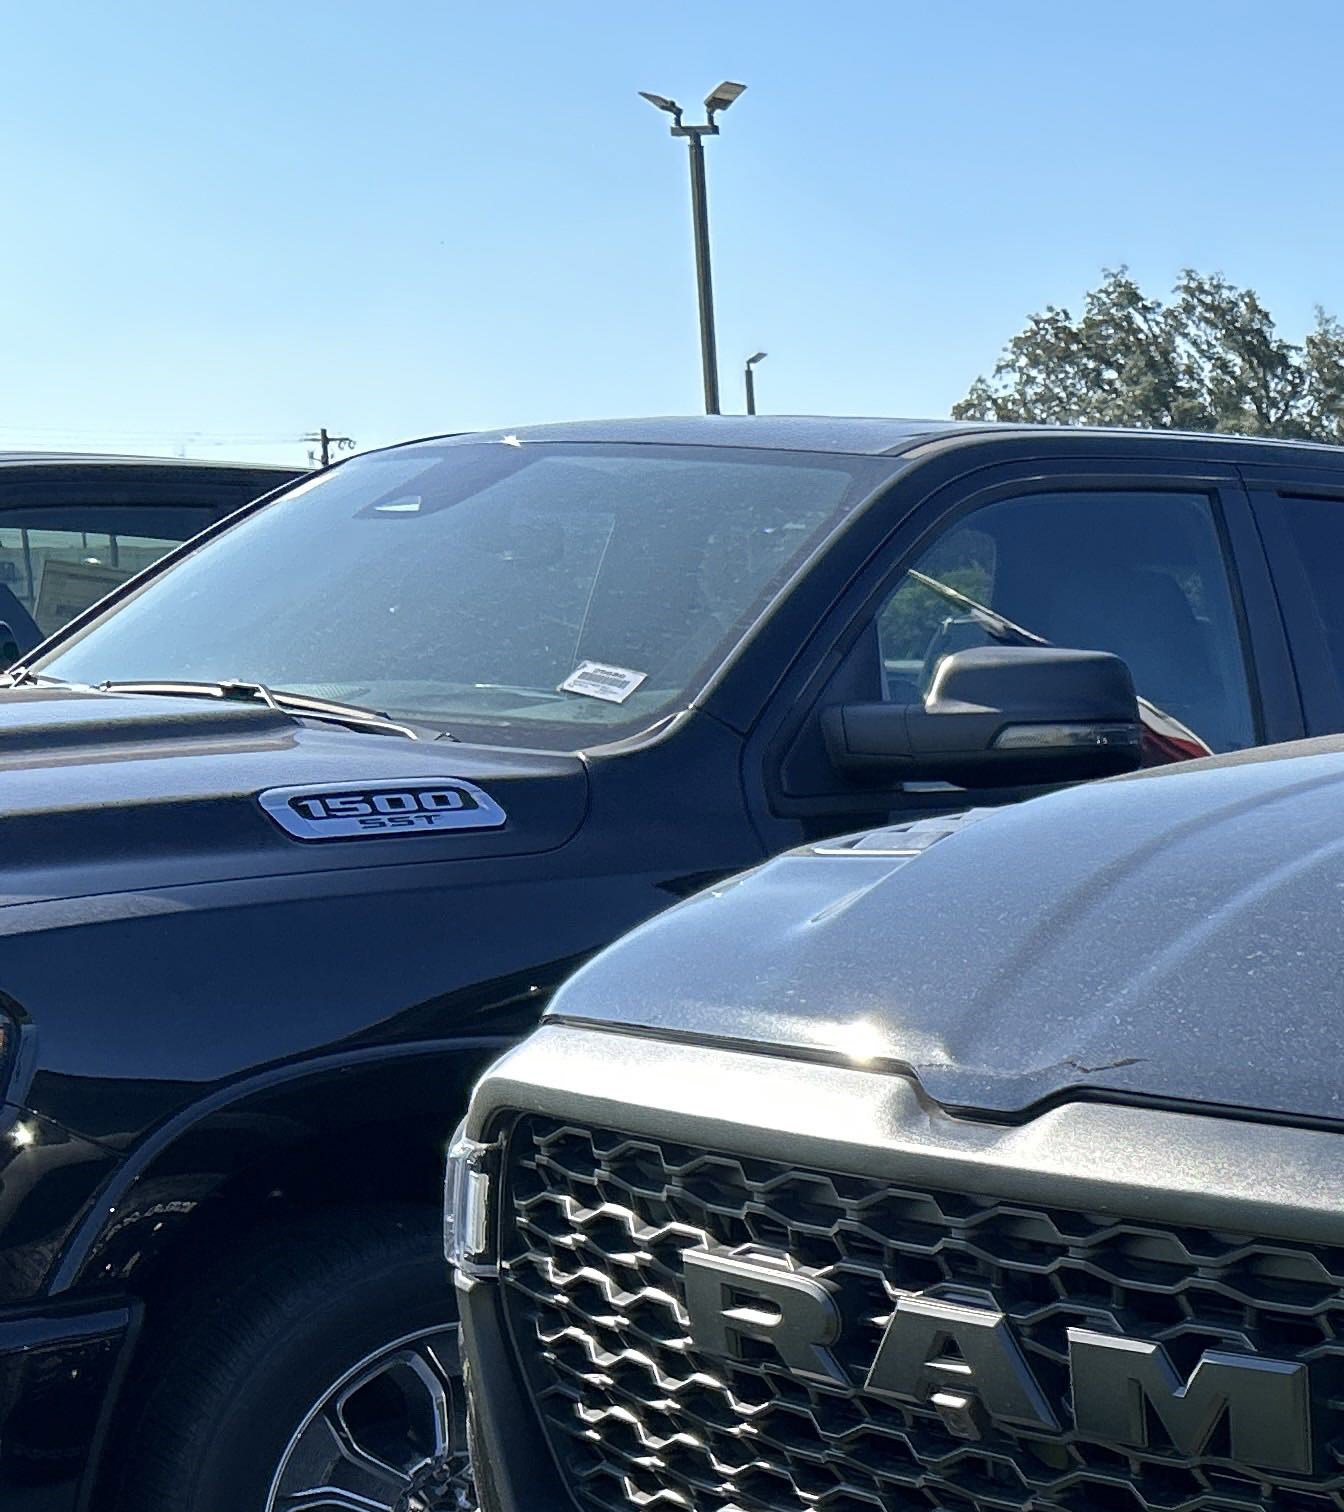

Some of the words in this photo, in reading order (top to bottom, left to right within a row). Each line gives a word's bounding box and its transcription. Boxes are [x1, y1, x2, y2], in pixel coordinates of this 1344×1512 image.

[297, 791, 464, 818] 1500
[358, 814, 441, 829] SST
[682, 1247, 1314, 1475] RAM
